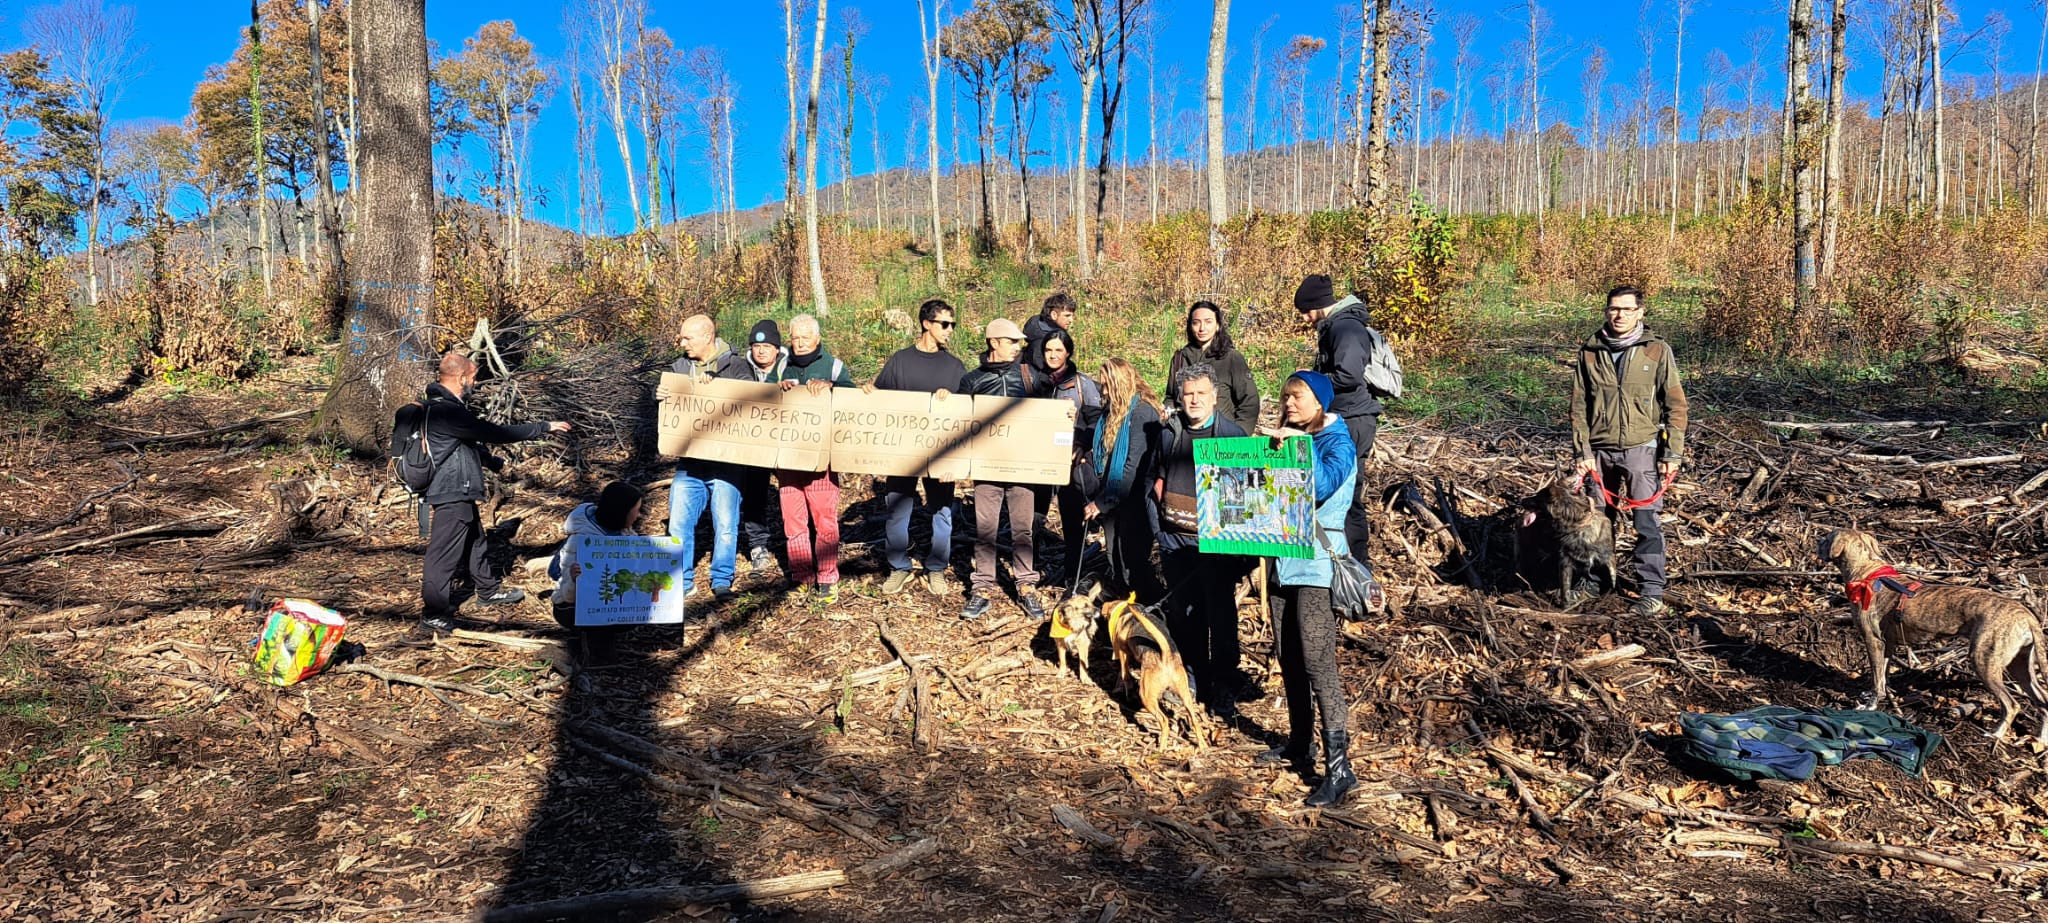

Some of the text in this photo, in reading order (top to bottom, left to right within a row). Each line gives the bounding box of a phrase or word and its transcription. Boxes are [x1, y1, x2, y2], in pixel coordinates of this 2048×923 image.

[664, 396, 822, 426] FANNO UN DESERTO
[833, 410, 1011, 438] PARCO DISBOSCATO DEI
[662, 413, 821, 443] LO CHIAMANO CEDUO
[833, 429, 975, 449] CASTELLI ROMANI
